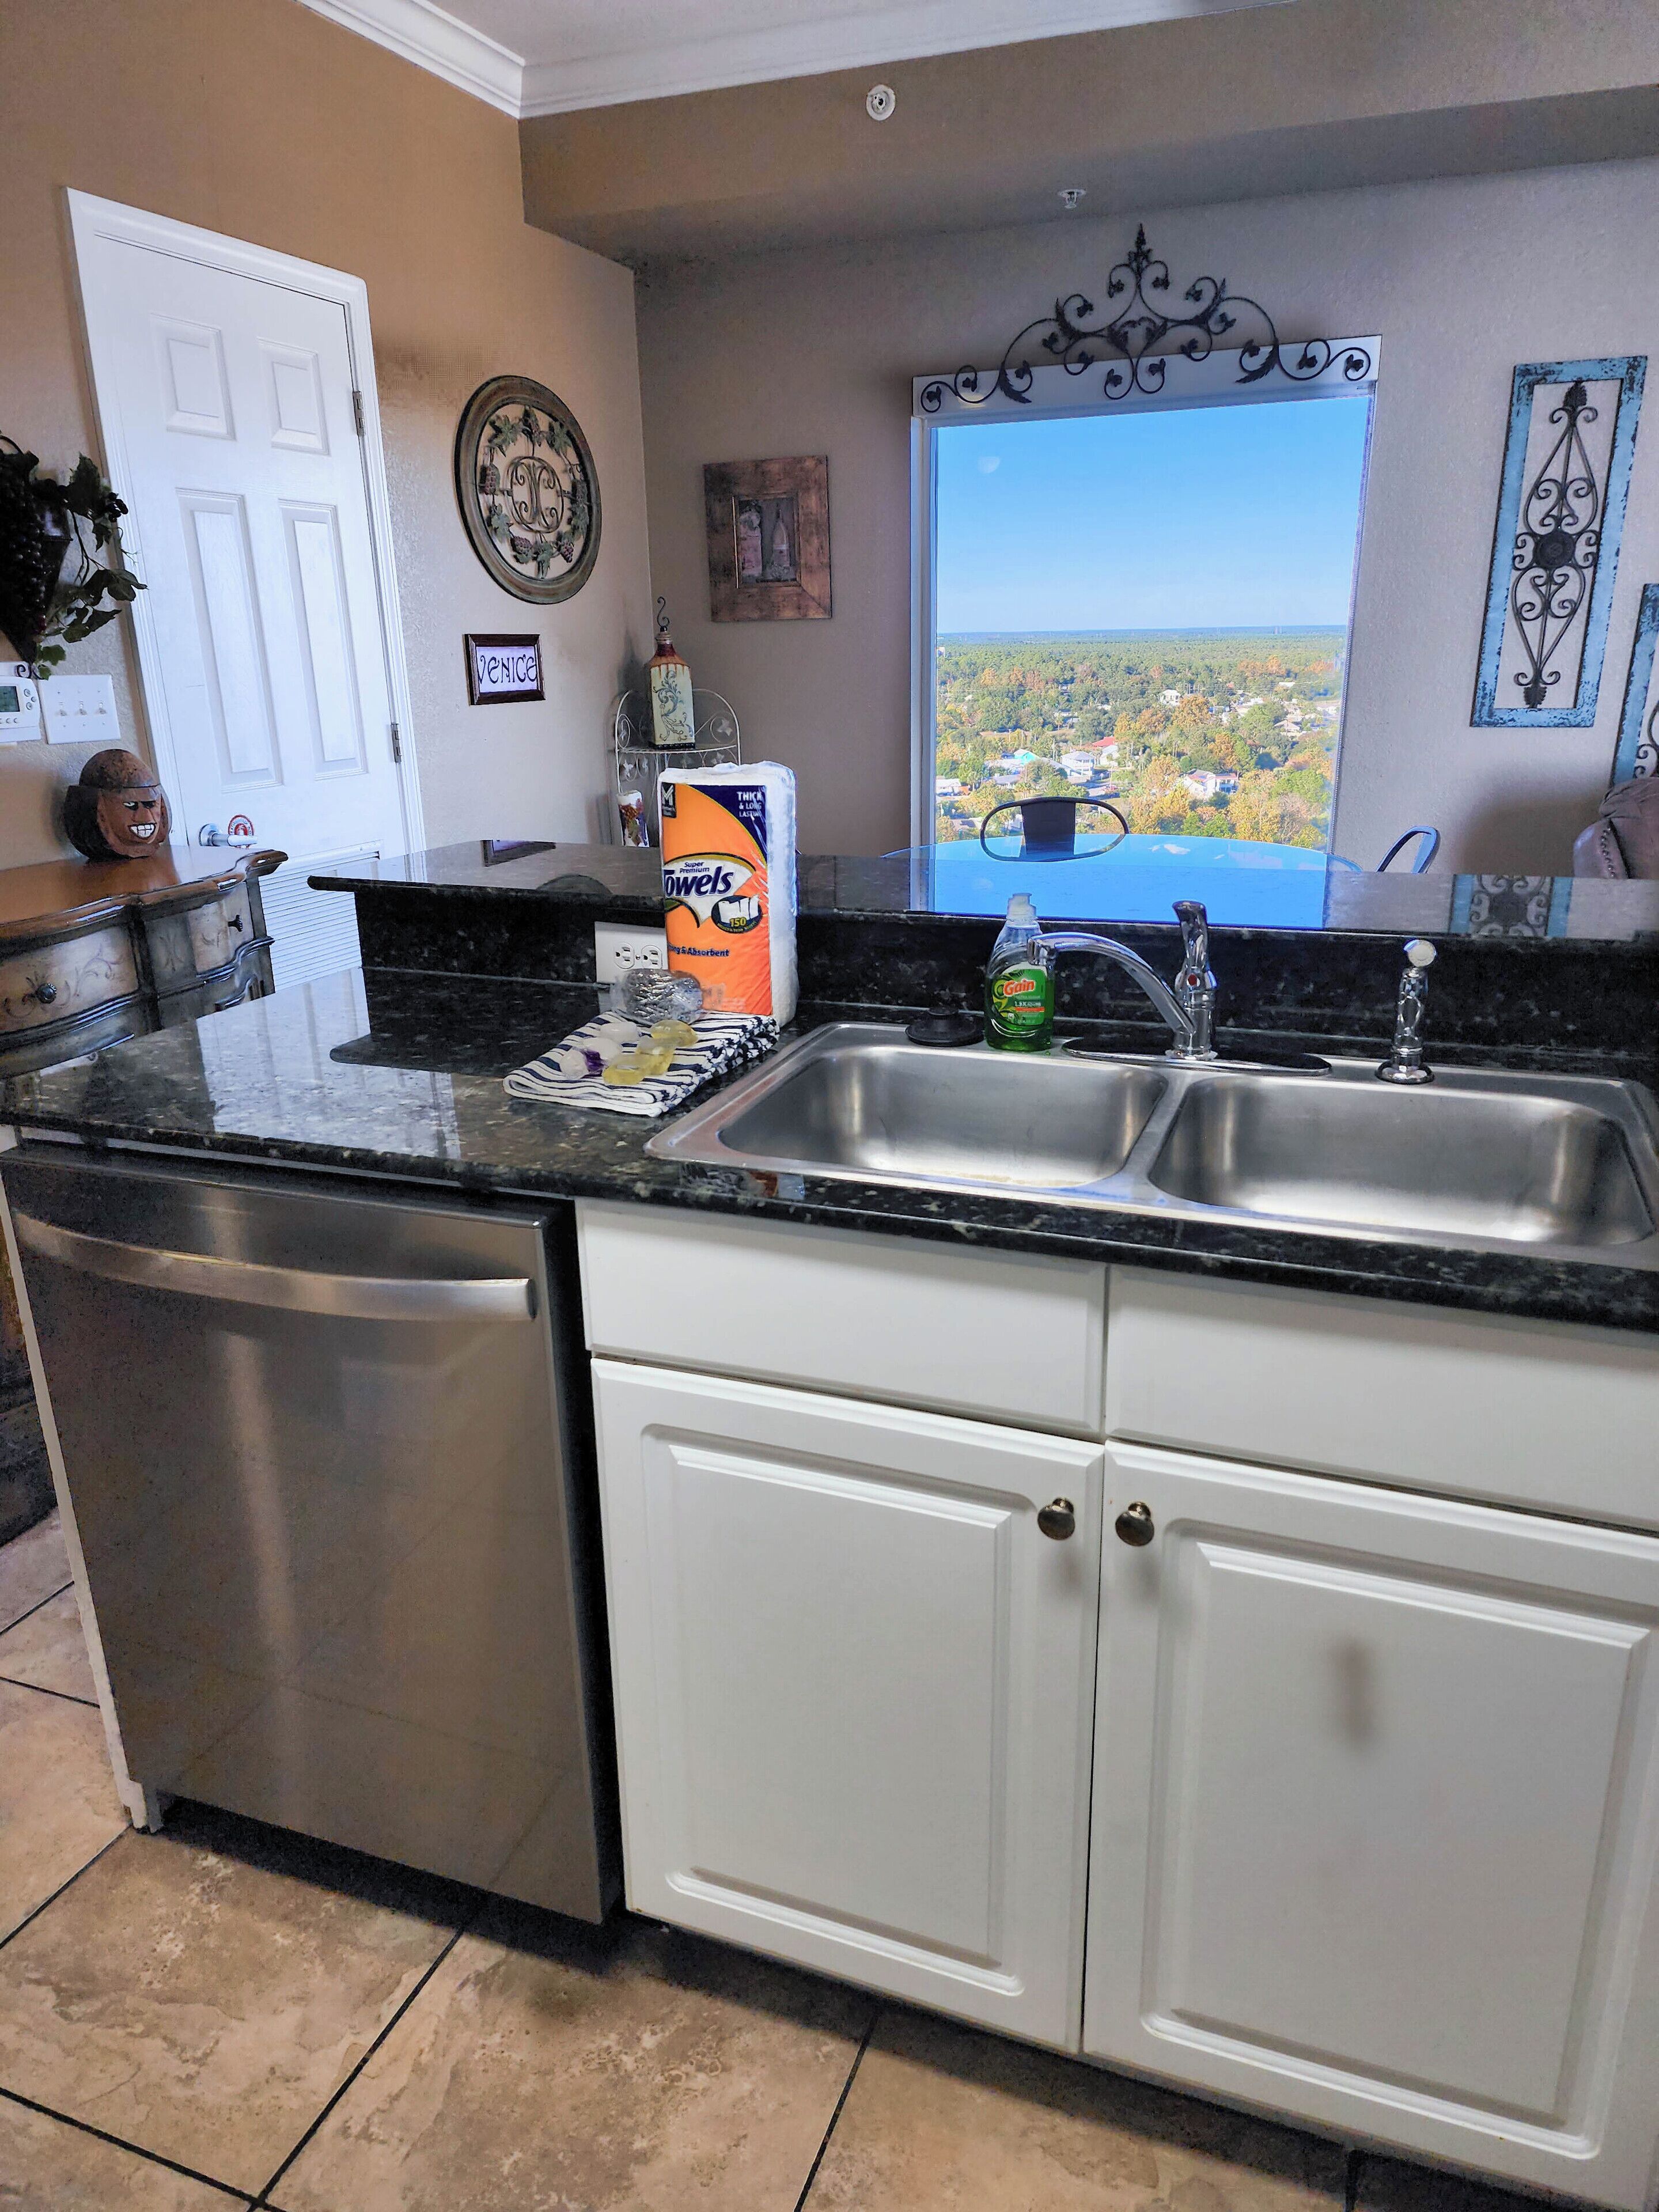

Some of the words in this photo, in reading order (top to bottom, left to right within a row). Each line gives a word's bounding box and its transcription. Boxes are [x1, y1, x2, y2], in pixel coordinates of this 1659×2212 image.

[476, 653, 538, 684] VENICE
[736, 791, 762, 801] THICK
[730, 917, 747, 927] 150
[687, 948, 729, 956] Absorbent
[1003, 978, 1035, 997] Gain
